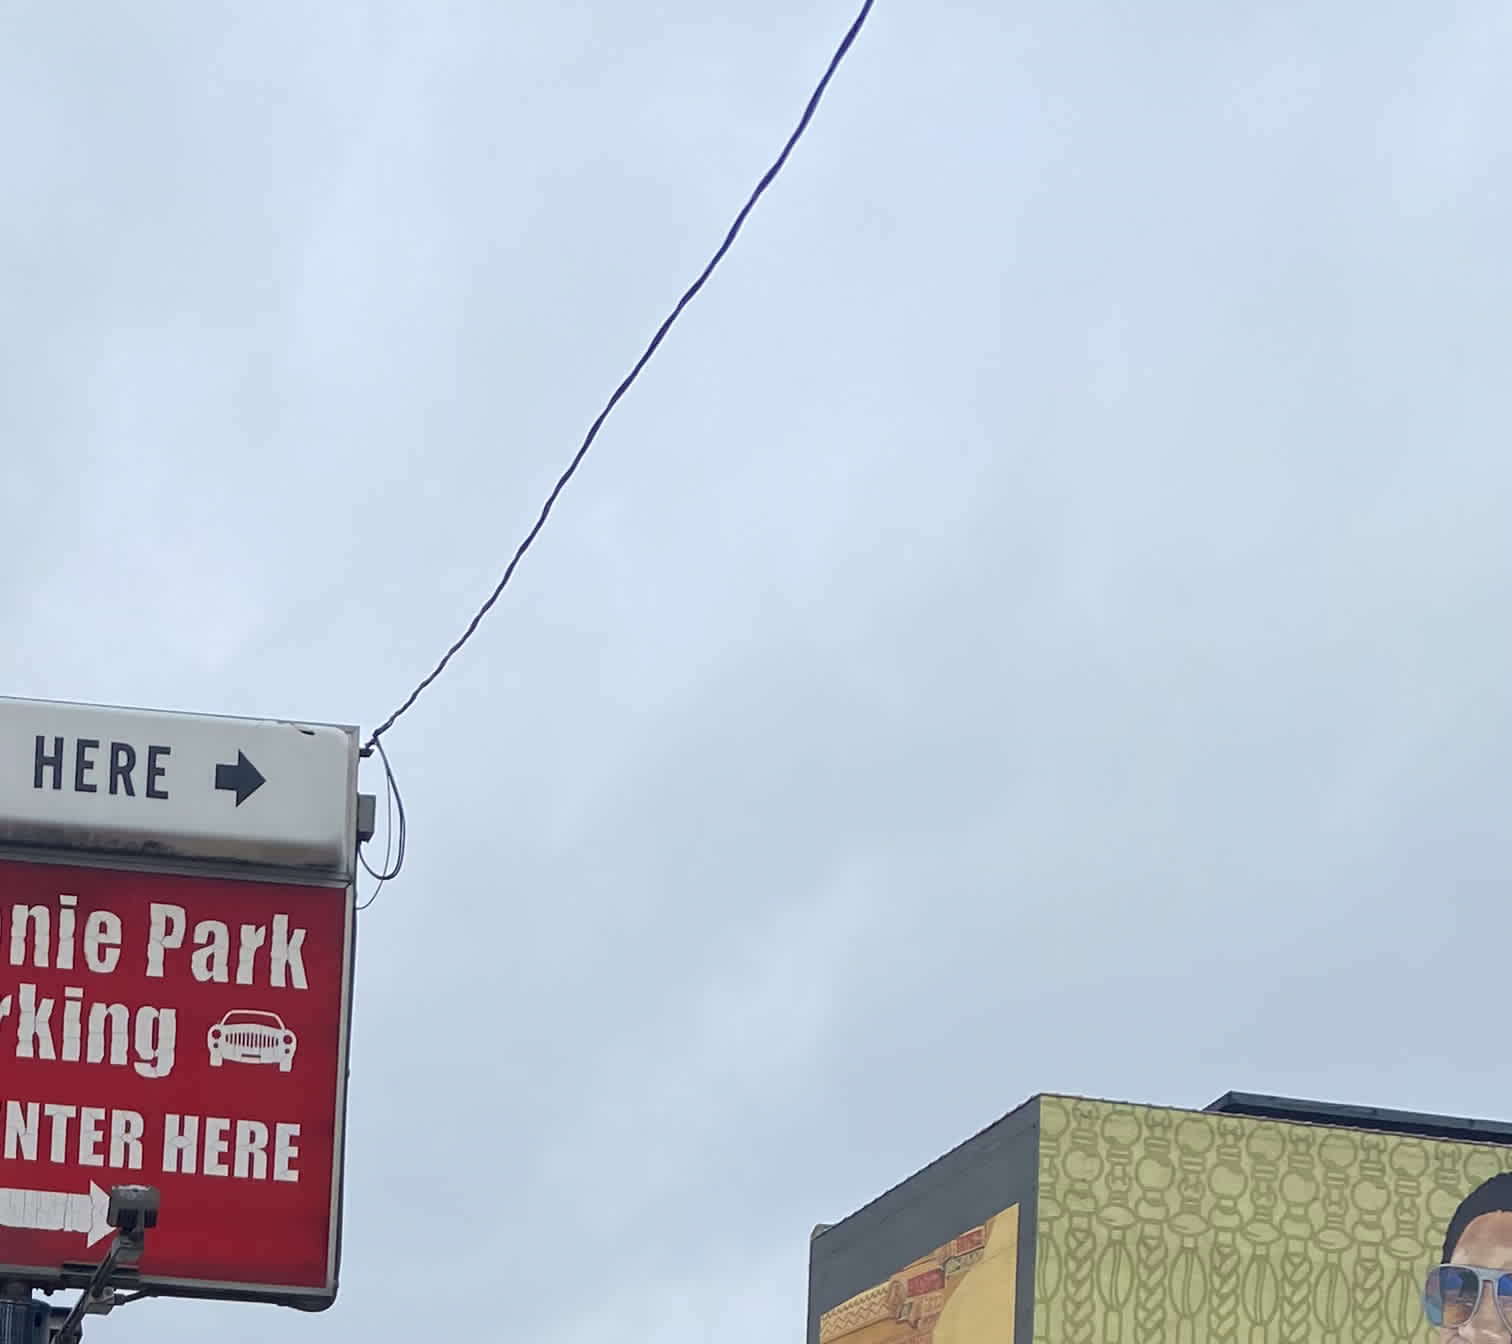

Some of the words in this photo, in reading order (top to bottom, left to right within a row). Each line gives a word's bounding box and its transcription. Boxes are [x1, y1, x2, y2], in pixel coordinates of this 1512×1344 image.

[33, 735, 172, 800] HERE
[145, 902, 308, 990] Park
[161, 1113, 301, 1183] HERE
